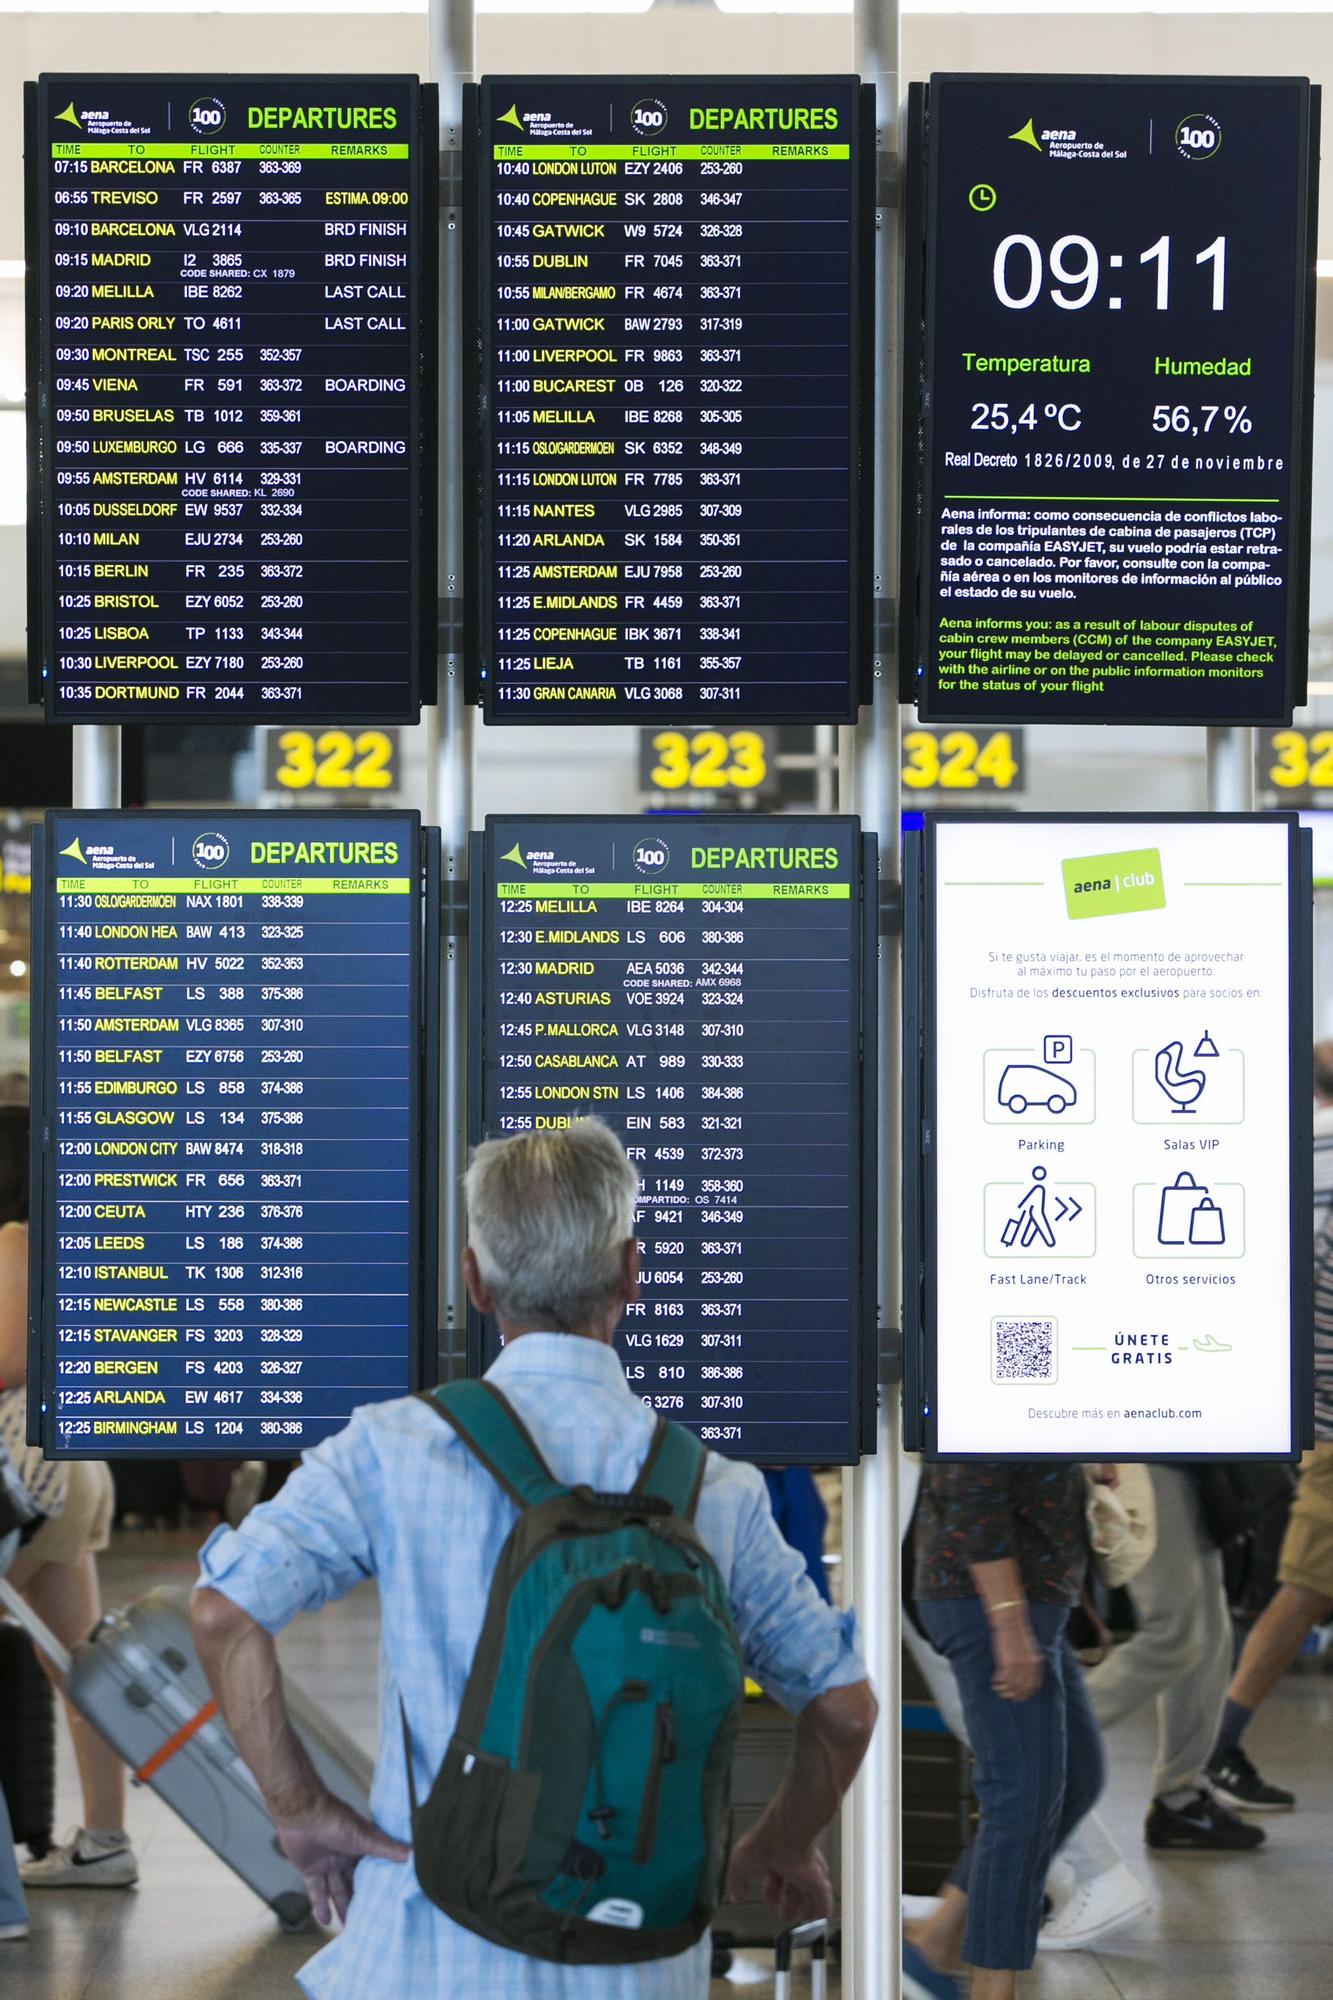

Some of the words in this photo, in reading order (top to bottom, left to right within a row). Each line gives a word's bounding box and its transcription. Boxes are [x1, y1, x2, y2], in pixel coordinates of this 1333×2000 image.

[193, 108, 220, 126] 100
[249, 107, 396, 129] DEPARTURES
[690, 108, 838, 129] DEPARTURES
[1041, 130, 1077, 141] aena
[1181, 126, 1214, 148] 100
[56, 145, 80, 155] TIME
[128, 145, 145, 155] TO
[191, 145, 235, 155] FLIGHT
[260, 145, 300, 155] COUNTER
[332, 145, 387, 155] REMARKS
[1050, 142, 1092, 150] Aeropuerto
[1095, 142, 1104, 150] de
[1050, 150, 1099, 159] Málaga-Costa
[1101, 150, 1113, 159] del
[1115, 150, 1127, 159] Sol
[497, 163, 529, 174] 10:40
[533, 162, 578, 175] LONDON
[581, 162, 616, 175] LUTON
[625, 162, 650, 174] EZY
[654, 162, 683, 174] 2406
[701, 162, 742, 174] 253-260
[55, 254, 88, 266] 09:15
[92, 254, 151, 266] MADRID
[213, 254, 242, 266] 3865
[325, 254, 355, 266] BRD
[360, 254, 406, 267] FINISH
[253, 269, 267, 277] CX
[273, 269, 295, 277] 1879
[994, 234, 1225, 310] 09:11
[56, 317, 89, 329] 09:20
[92, 317, 134, 329] PARIS
[138, 317, 175, 329] ORLY
[184, 317, 205, 329] TO
[213, 317, 240, 329] 4611
[325, 317, 363, 330] LAST
[367, 317, 406, 330] CALL
[962, 353, 1090, 376] Temperatura
[1155, 357, 1251, 375] Humedad
[57, 441, 89, 453] 09:50
[93, 441, 177, 453] LUXEMBURGO
[185, 441, 205, 453] LG
[218, 441, 244, 453] 666
[261, 442, 302, 454] 335-337
[326, 441, 405, 453] BOARDING
[946, 452, 970, 466] Real
[974, 452, 1017, 467] Decreto
[1123, 455, 1140, 468] de
[1147, 455, 1164, 468] 27
[1171, 455, 1189, 469] de
[941, 508, 975, 519] Aena
[978, 509, 1030, 520] informa:
[1034, 512, 1069, 520] como
[1073, 511, 1161, 521] consecuencia
[1165, 511, 1181, 521] de
[1184, 511, 1247, 522] conflictos
[1250, 512, 1282, 523] labo-
[941, 540, 957, 550] de
[964, 540, 975, 550] la
[978, 541, 1041, 553] compañía
[1045, 541, 1106, 554] EASYJET,
[1109, 544, 1124, 552] su
[1128, 542, 1162, 553] vuelo
[1166, 543, 1206, 555] podría
[1210, 544, 1243, 554] estar
[1247, 544, 1282, 554] retra-
[940, 618, 972, 628] Aena
[976, 618, 1022, 628] informs
[1026, 621, 1051, 631] you:
[1085, 620, 1119, 630] result
[1119, 620, 1136, 630] of
[1141, 620, 1180, 630] labour
[1184, 621, 1237, 633] disputes
[1241, 621, 1253, 631] of
[499, 688, 530, 699] 11:30
[534, 687, 565, 699] GRAN
[568, 687, 616, 699] CANARIA
[625, 687, 651, 699] VLG
[654, 687, 682, 699] 3068
[700, 687, 739, 699] 307-311
[277, 731, 392, 788] 322
[651, 731, 766, 788] 323
[902, 731, 1017, 788] 324
[196, 842, 224, 860] 100
[251, 842, 400, 864] DEPARTURES
[692, 848, 838, 869] DEPARTURES
[1073, 877, 1111, 894] aena
[1123, 872, 1155, 889] club
[501, 931, 532, 943] 12:30
[536, 931, 619, 943] E.MIDLANDS
[627, 931, 645, 943] LS
[659, 931, 685, 943] 606
[702, 931, 743, 943] 380-386
[60, 957, 92, 969] 11:40
[95, 957, 178, 969] ROTTERDAM
[187, 957, 207, 969] HV
[215, 957, 244, 969] 5022
[262, 957, 303, 969] 352-353
[989, 952, 997, 962] Si
[1002, 953, 1013, 962] te
[1016, 953, 1046, 964] gusta
[1050, 952, 1081, 964] viajar,
[1101, 952, 1109, 961] el
[1114, 953, 1164, 961] momento
[1168, 952, 1181, 961] de
[1185, 952, 1243, 963] aprovechar
[970, 987, 1013, 998] Disfruta
[1017, 988, 1030, 998] de
[1034, 988, 1048, 998] los
[1052, 988, 1117, 997] descuentos
[1121, 988, 1179, 997] exclusivos
[1183, 990, 1206, 999] para
[1210, 990, 1243, 998] socios
[1247, 990, 1262, 998] en:
[500, 1055, 532, 1067] 12:50
[535, 1055, 618, 1067] CASABLANCA
[626, 1055, 646, 1067] AT
[660, 1056, 685, 1067] 989
[702, 1056, 743, 1067] 330-333
[1019, 1140, 1064, 1152] Parking
[1164, 1140, 1195, 1149] Salas
[1200, 1140, 1219, 1149] VIP
[991, 1274, 1015, 1284] Fast
[1021, 1274, 1086, 1284] Lane/Track
[1146, 1274, 1178, 1284] Otros
[1183, 1274, 1235, 1284] servicios
[627, 1303, 645, 1315] FR
[655, 1304, 684, 1315] 8163
[701, 1304, 741, 1315] 363-371
[1115, 1332, 1168, 1345] ÚNETE
[1112, 1353, 1172, 1364] GRATIS
[1029, 1408, 1078, 1418] Descubre
[1082, 1408, 1103, 1418] más
[1124, 1409, 1201, 1418] aenaclub.com
[59, 1421, 91, 1434] 12:25
[94, 1421, 177, 1434] BIRMINGHAM
[186, 1421, 204, 1434] LS
[215, 1422, 243, 1434] 1204
[261, 1422, 302, 1434] 380-386
